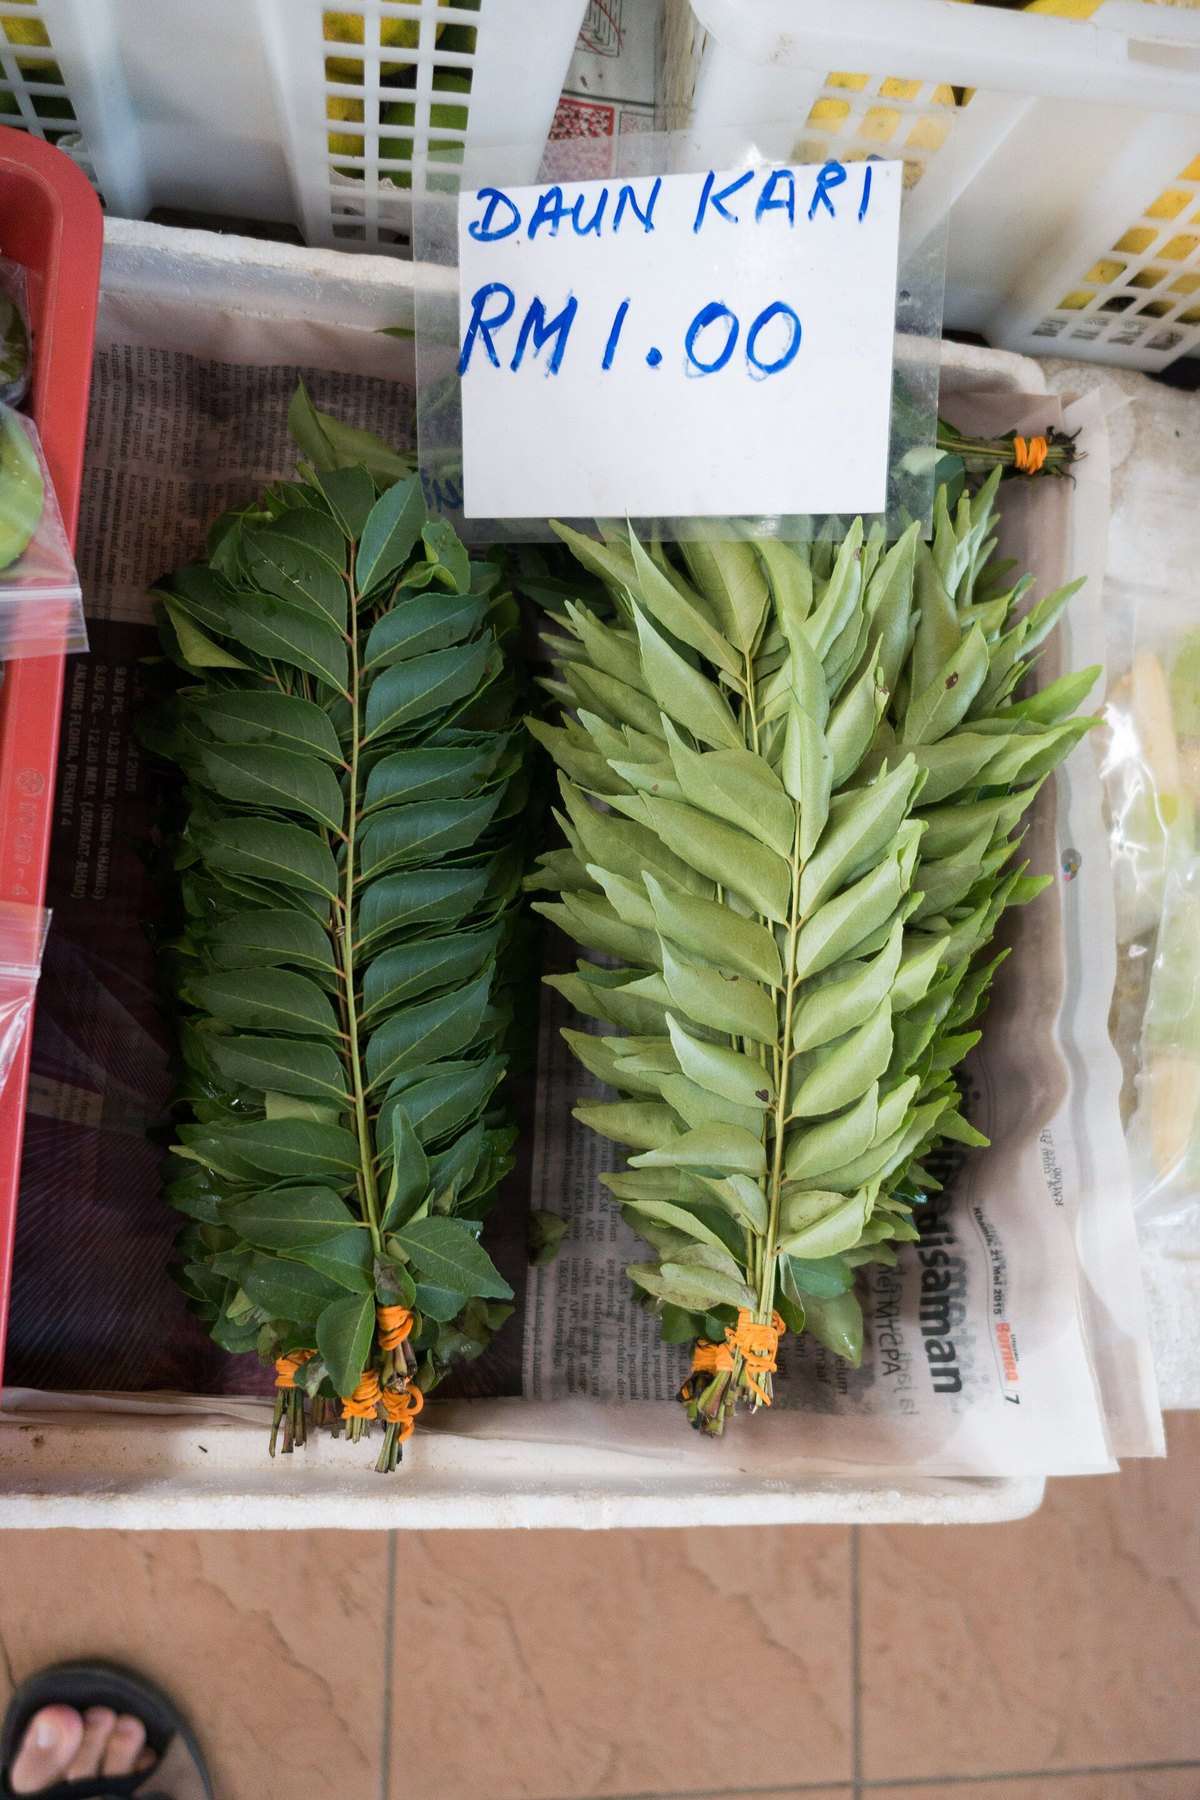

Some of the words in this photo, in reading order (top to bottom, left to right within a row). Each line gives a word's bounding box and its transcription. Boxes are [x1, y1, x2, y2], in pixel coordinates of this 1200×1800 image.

[468, 176, 662, 241] DAUN
[694, 162, 872, 233] KARI
[457, 282, 802, 381] RM1.00
[71, 663, 88, 710] ANJUNG
[106, 730, 121, 764] 10.30
[62, 764, 79, 814] PRESINT
[61, 817, 73, 826] 4
[972, 1207, 994, 1247] Khamis,
[989, 1250, 999, 1262] 21
[992, 1266, 1002, 1285] Mei
[569, 1299, 580, 1325] APC
[992, 1288, 1002, 1315] 2015
[874, 1301, 901, 1377] MTCPA
[995, 1322, 1019, 1382] Borneo
[1004, 1393, 1020, 1406] 7
